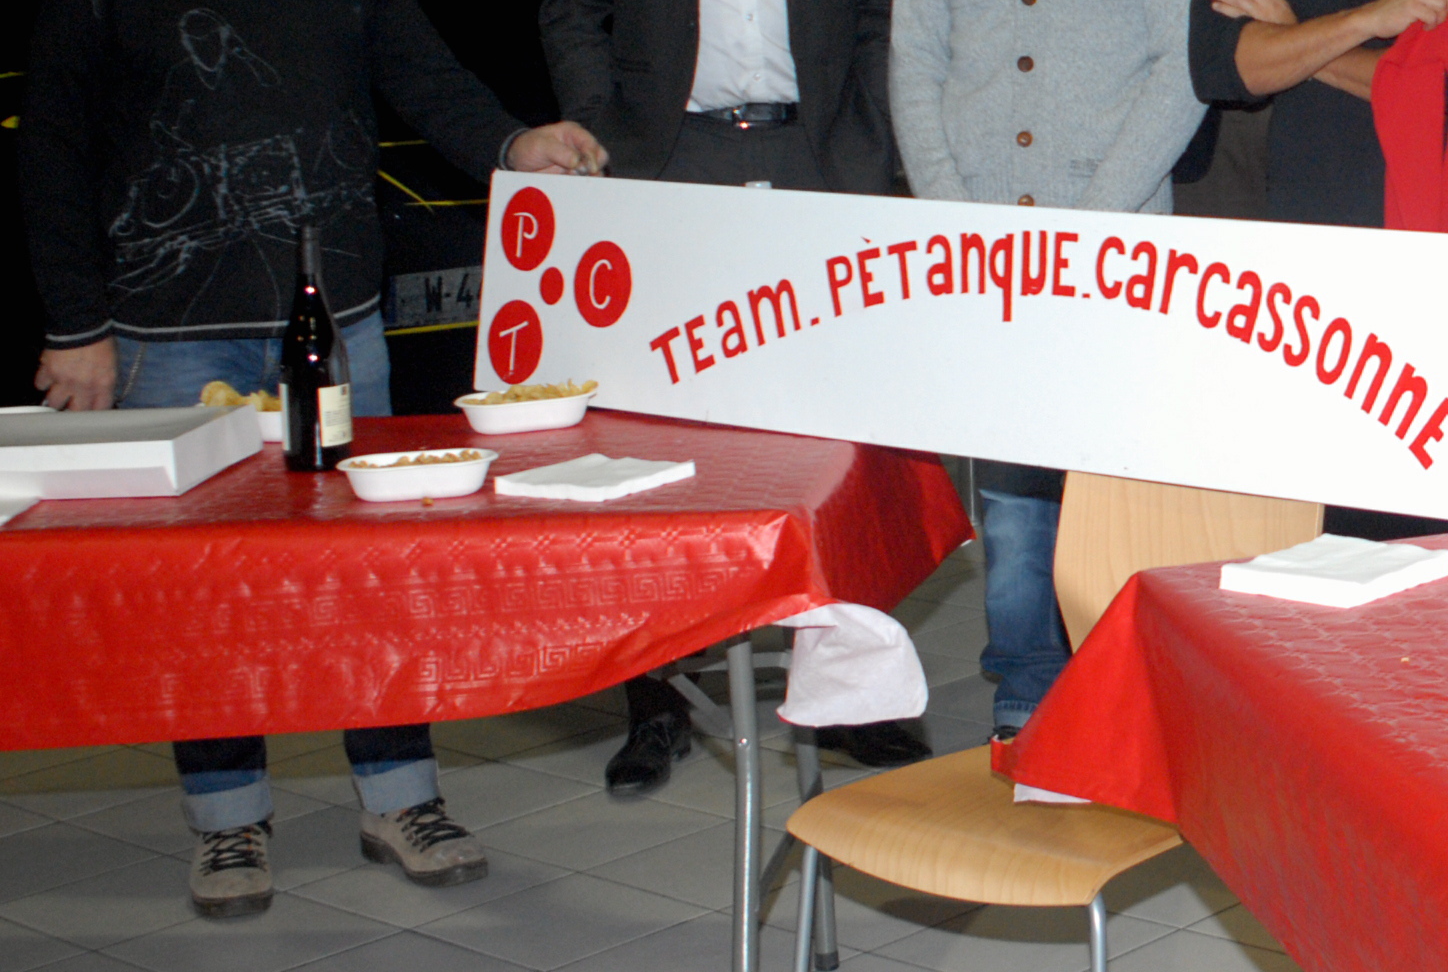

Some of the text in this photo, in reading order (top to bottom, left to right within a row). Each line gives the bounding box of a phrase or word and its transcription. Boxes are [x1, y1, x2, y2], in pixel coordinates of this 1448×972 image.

[513, 211, 538, 258] P
[589, 259, 613, 309] C
[499, 320, 529, 372] T
